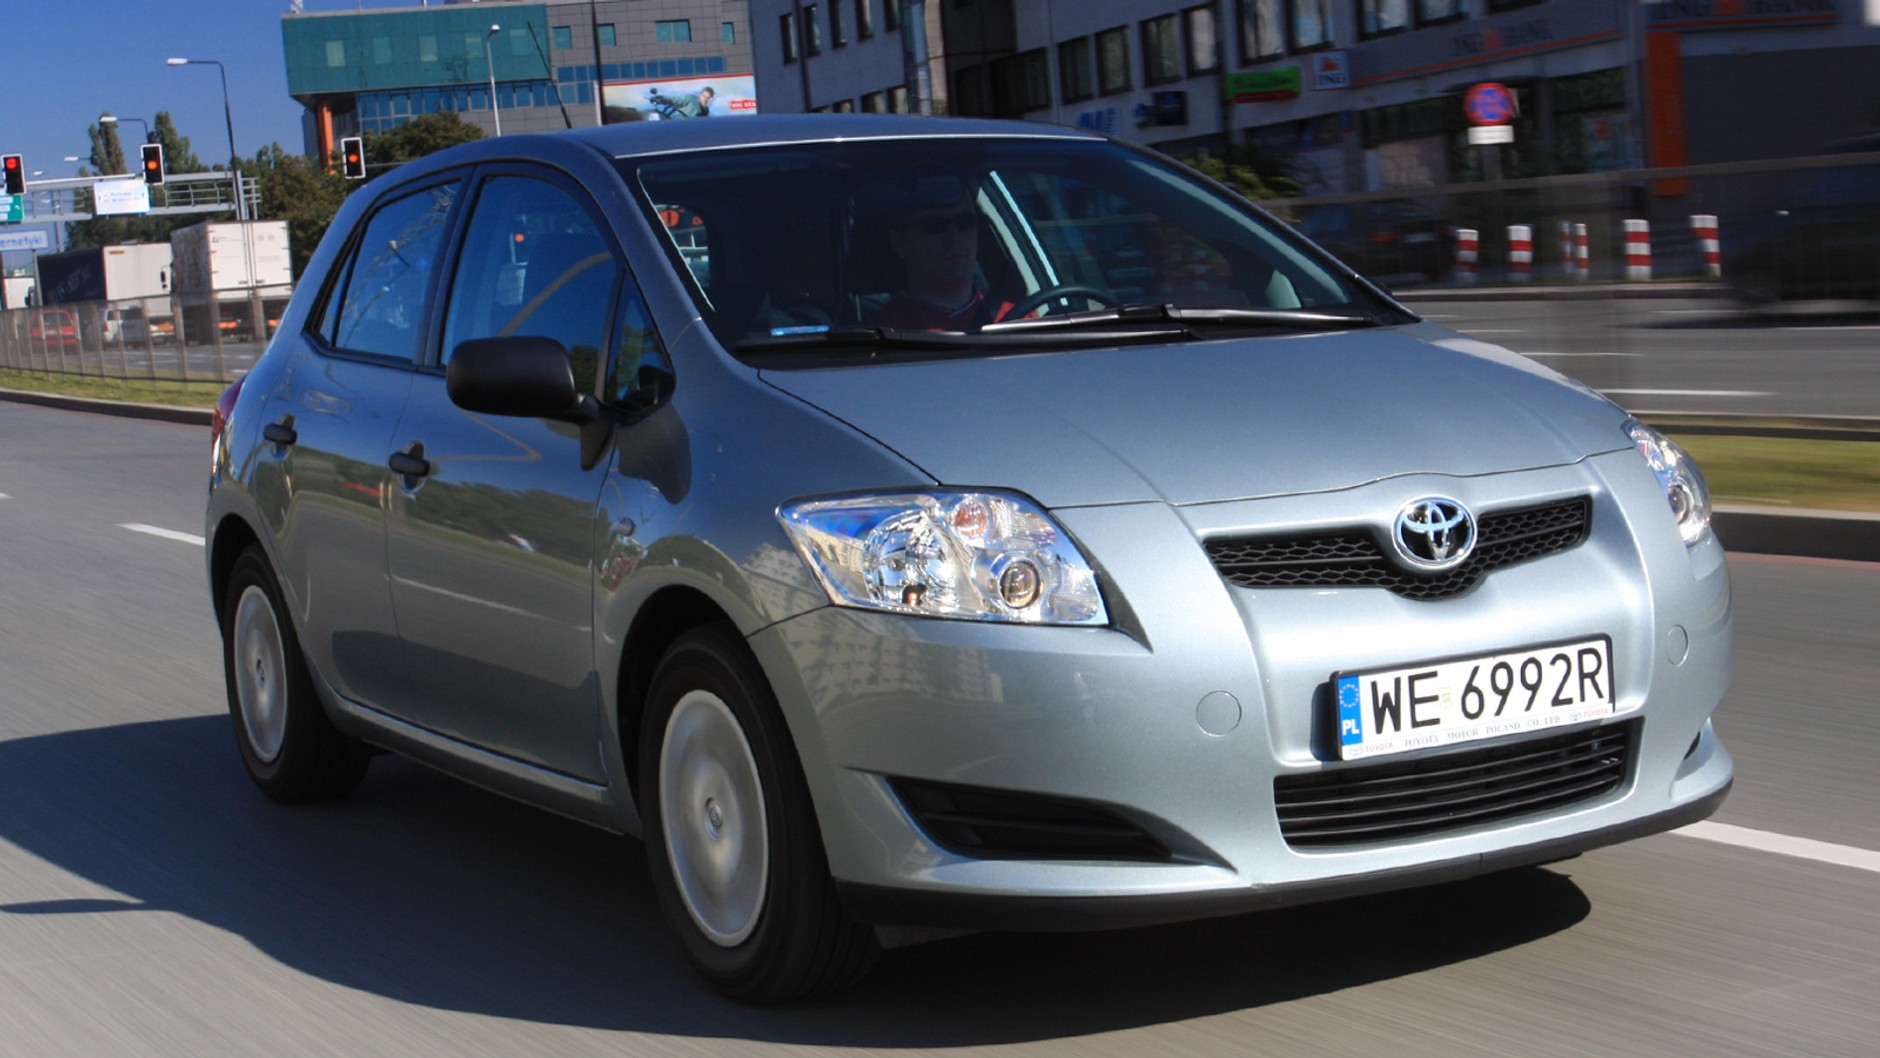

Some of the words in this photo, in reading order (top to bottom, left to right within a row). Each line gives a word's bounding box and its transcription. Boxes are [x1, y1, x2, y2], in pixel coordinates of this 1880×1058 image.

[1317, 74, 1346, 86] ING
[1371, 670, 1441, 734] WE
[1460, 648, 1604, 720] 6992R
[1583, 708, 1609, 718] TOYOTA
[1342, 719, 1360, 735] PL
[1404, 735, 1439, 748] TOYOTA
[1446, 728, 1479, 740] MOTOR
[1485, 722, 1521, 734] POLAND
[1365, 742, 1394, 753] TOYOTA
